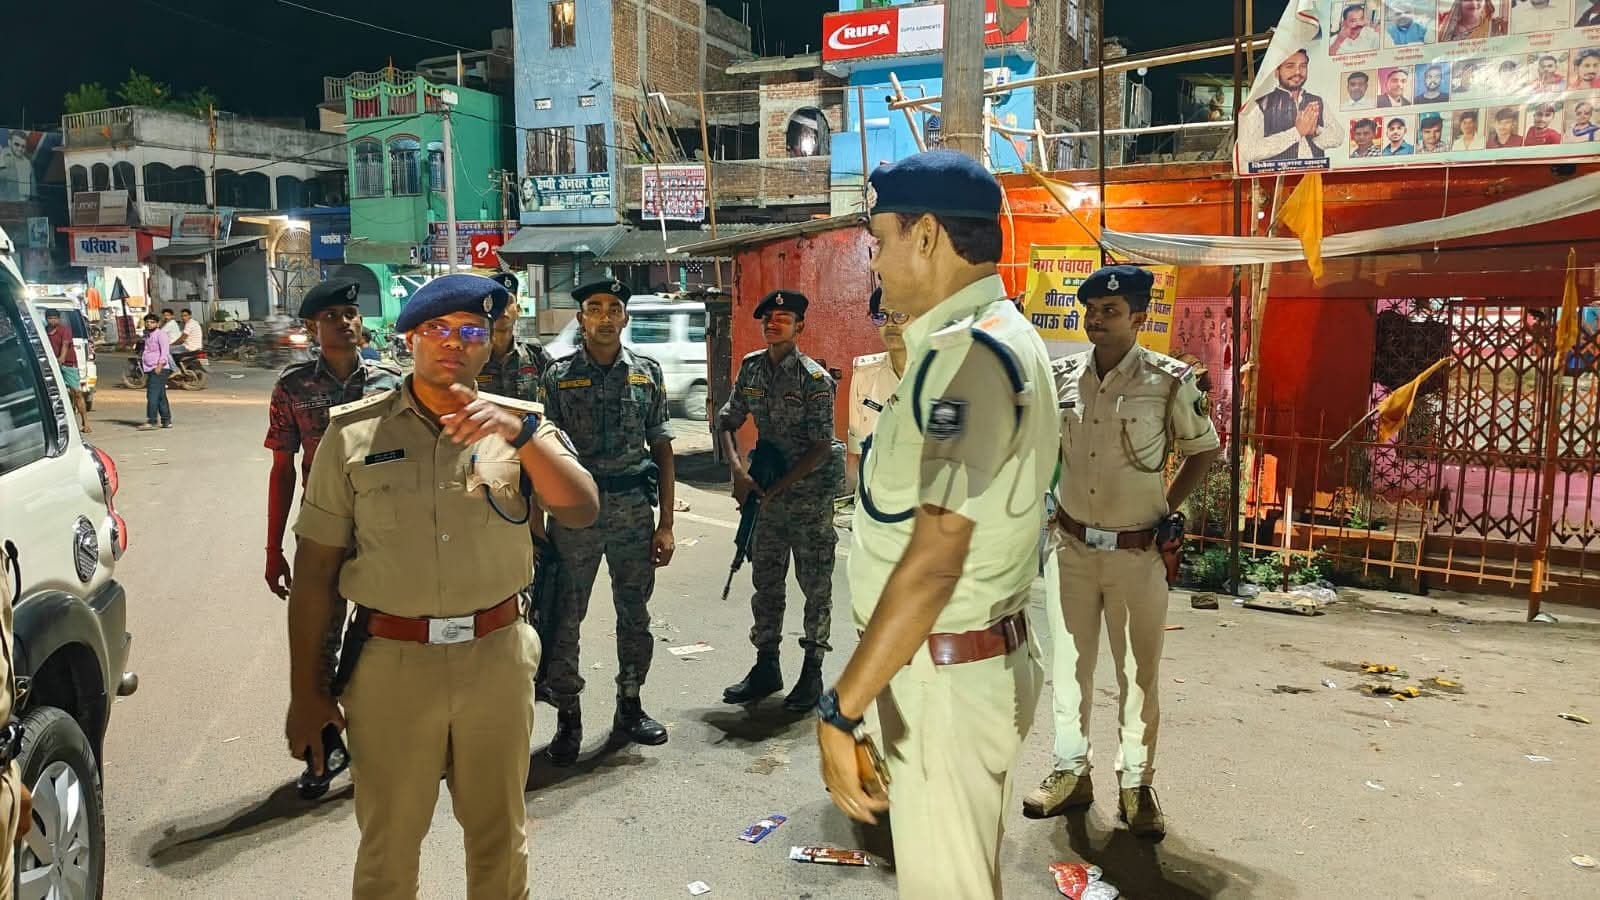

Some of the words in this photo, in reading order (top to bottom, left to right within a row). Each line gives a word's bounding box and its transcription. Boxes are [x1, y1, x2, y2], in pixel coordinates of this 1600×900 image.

[843, 23, 890, 39] RUPA
[80, 237, 118, 253] परिवार
[1033, 258, 1055, 272] नगर
[1057, 256, 1094, 273] पंचायत
[1045, 289, 1076, 307] शीतल
[1031, 312, 1060, 330] प्याऊ
[1063, 310, 1080, 330] की
